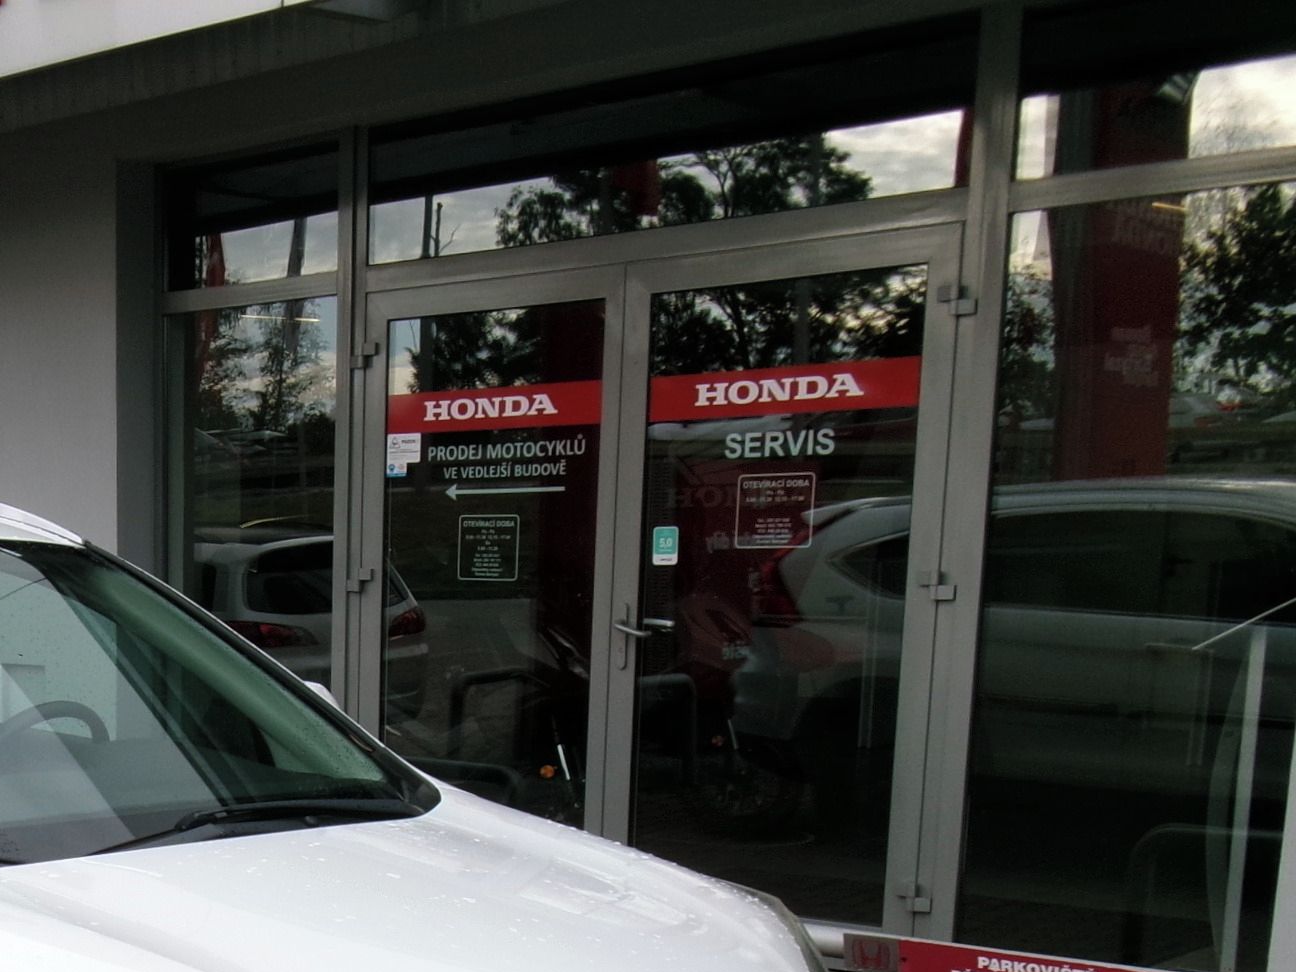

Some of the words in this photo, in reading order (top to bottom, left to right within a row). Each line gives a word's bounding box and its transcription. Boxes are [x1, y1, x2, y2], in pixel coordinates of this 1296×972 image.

[694, 373, 864, 407] HONDA
[424, 393, 558, 421] HONDA
[428, 444, 483, 462] PRODEJ
[487, 433, 587, 460] MOTOCYKLŮ
[724, 428, 835, 460] SERVIS
[443, 467, 458, 480] VE
[460, 462, 513, 479] VEDLEJŠÍ
[514, 459, 567, 478] BUDOVĚ
